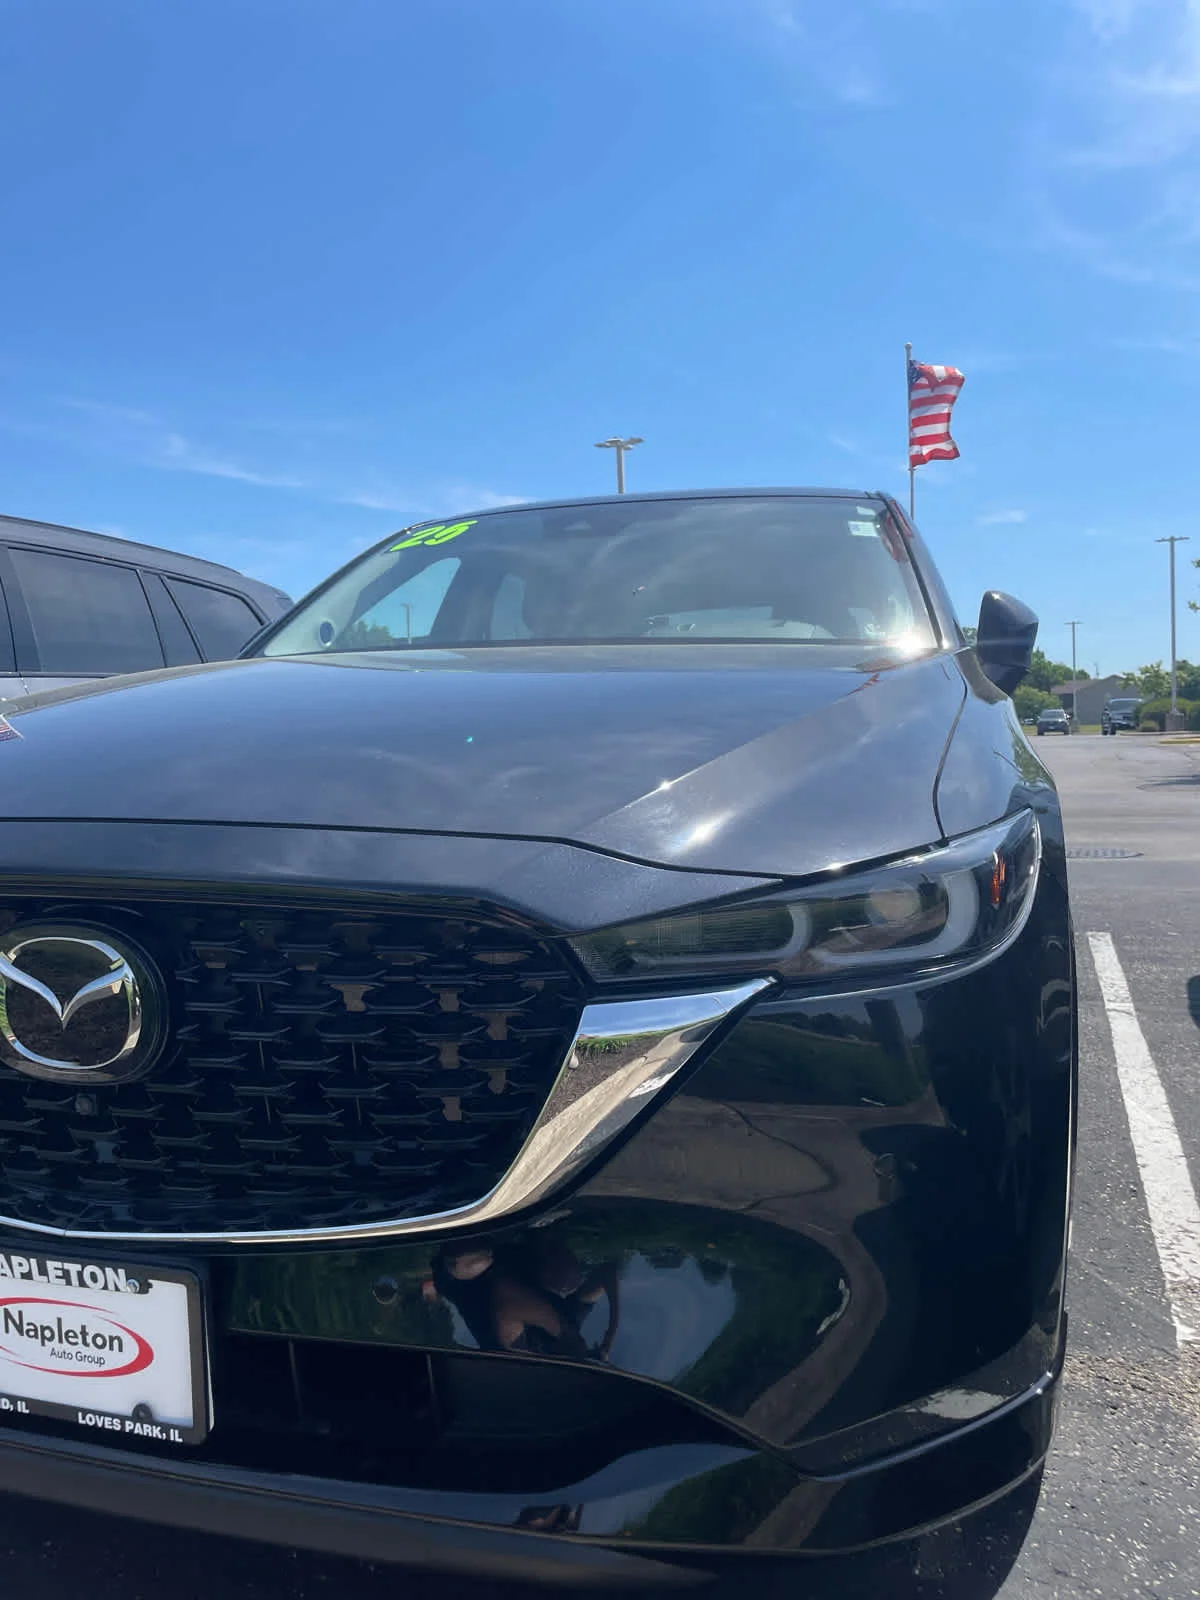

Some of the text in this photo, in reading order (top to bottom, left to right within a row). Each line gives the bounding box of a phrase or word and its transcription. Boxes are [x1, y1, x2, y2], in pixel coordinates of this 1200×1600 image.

[3, 1307, 123, 1353] Napleton
[50, 1347, 106, 1367] Auto Group
[16, 1400, 30, 1414] IL
[78, 1411, 183, 1443] LOVES PARK, IL
